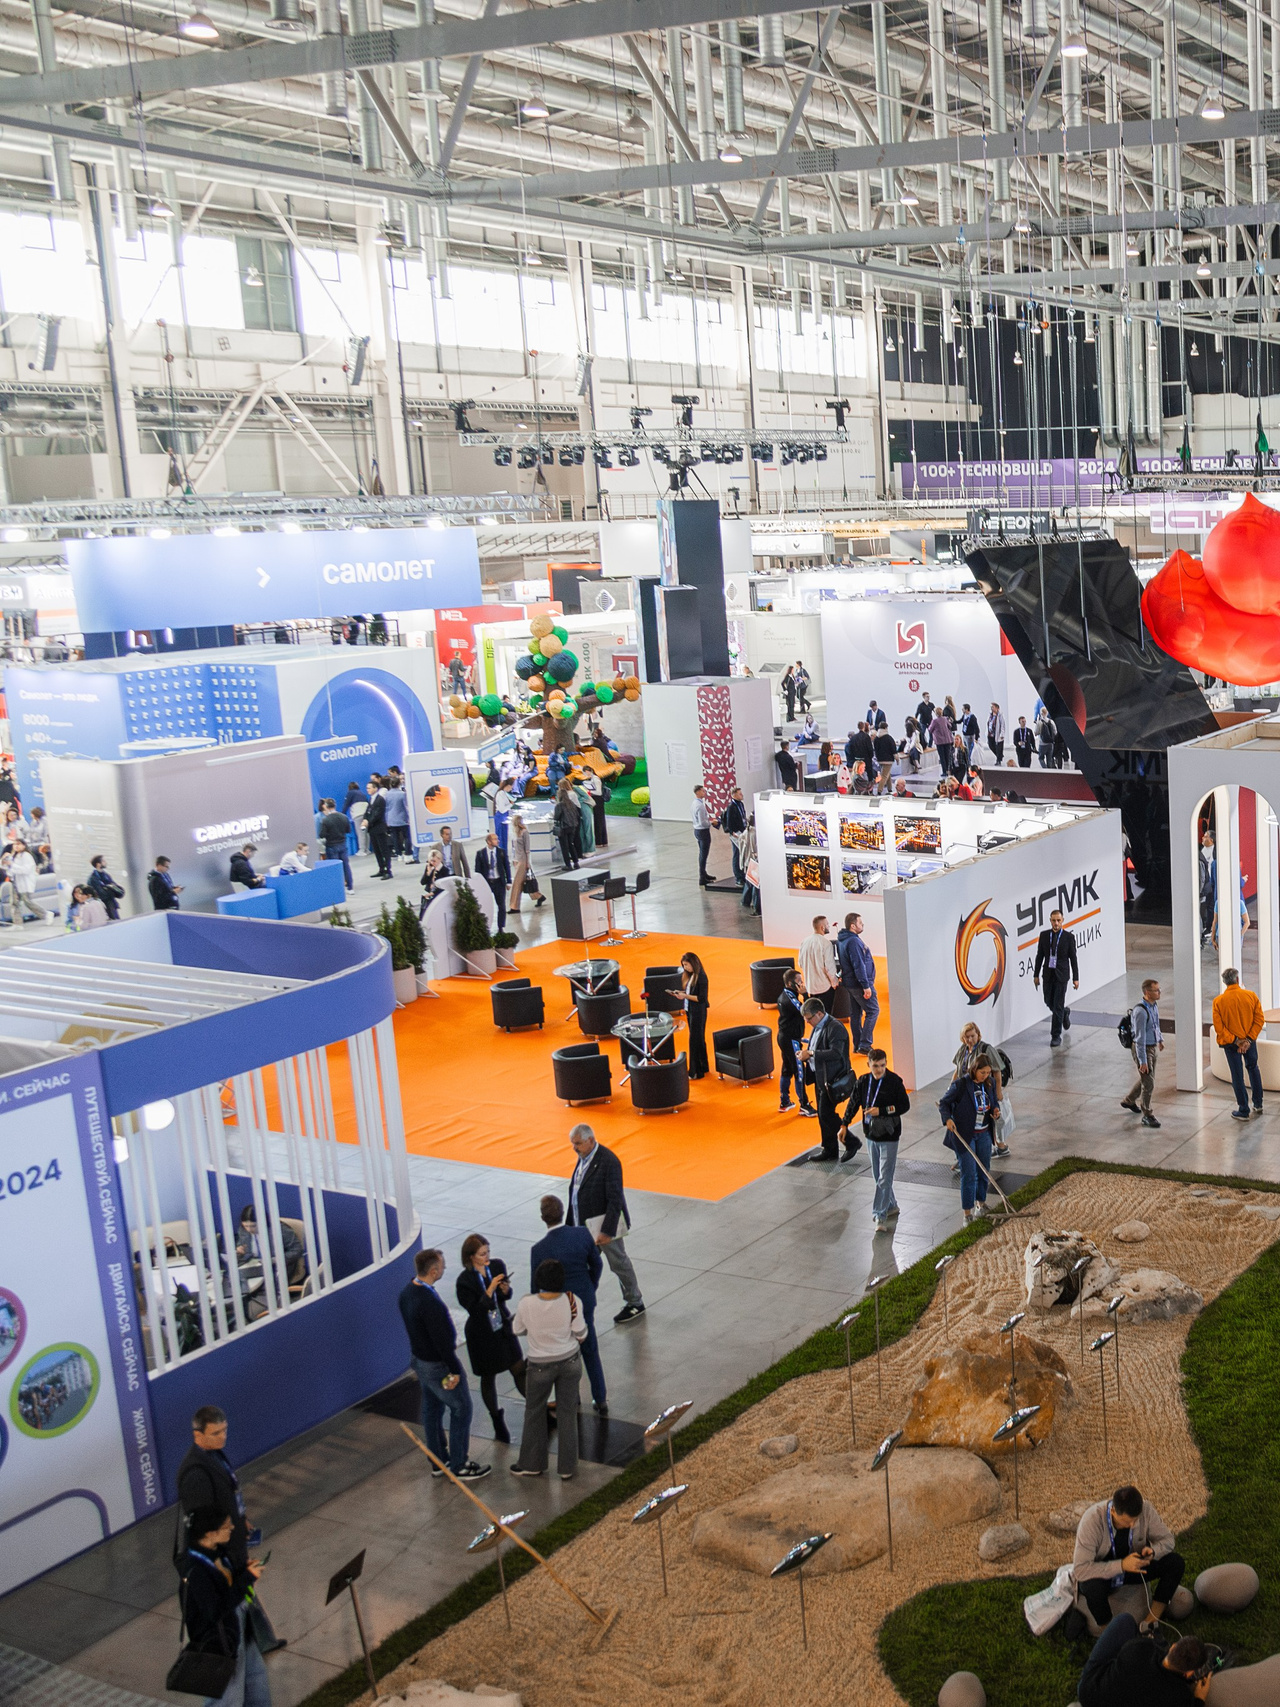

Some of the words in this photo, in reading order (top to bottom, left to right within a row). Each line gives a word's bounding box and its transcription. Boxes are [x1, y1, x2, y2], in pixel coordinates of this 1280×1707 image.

[919, 464, 955, 478] 100+
[956, 461, 1051, 477] TECHNOBUILD
[1078, 460, 1116, 475] 2024
[323, 557, 436, 585] самолет
[894, 661, 933, 672] синара
[320, 741, 379, 763] самолет
[195, 814, 270, 843] самолет
[196, 836, 252, 856] застройщик
[1016, 868, 1102, 937] УГМК
[1018, 922, 1102, 978] ЗАЩИК
[13, 1073, 71, 1099] СЕЙЧАС
[99, 1188, 118, 1244] СЕЙЧАС
[121, 1338, 140, 1392] СЕЙЧАС
[139, 1453, 157, 1505] СЕЙЧАС
